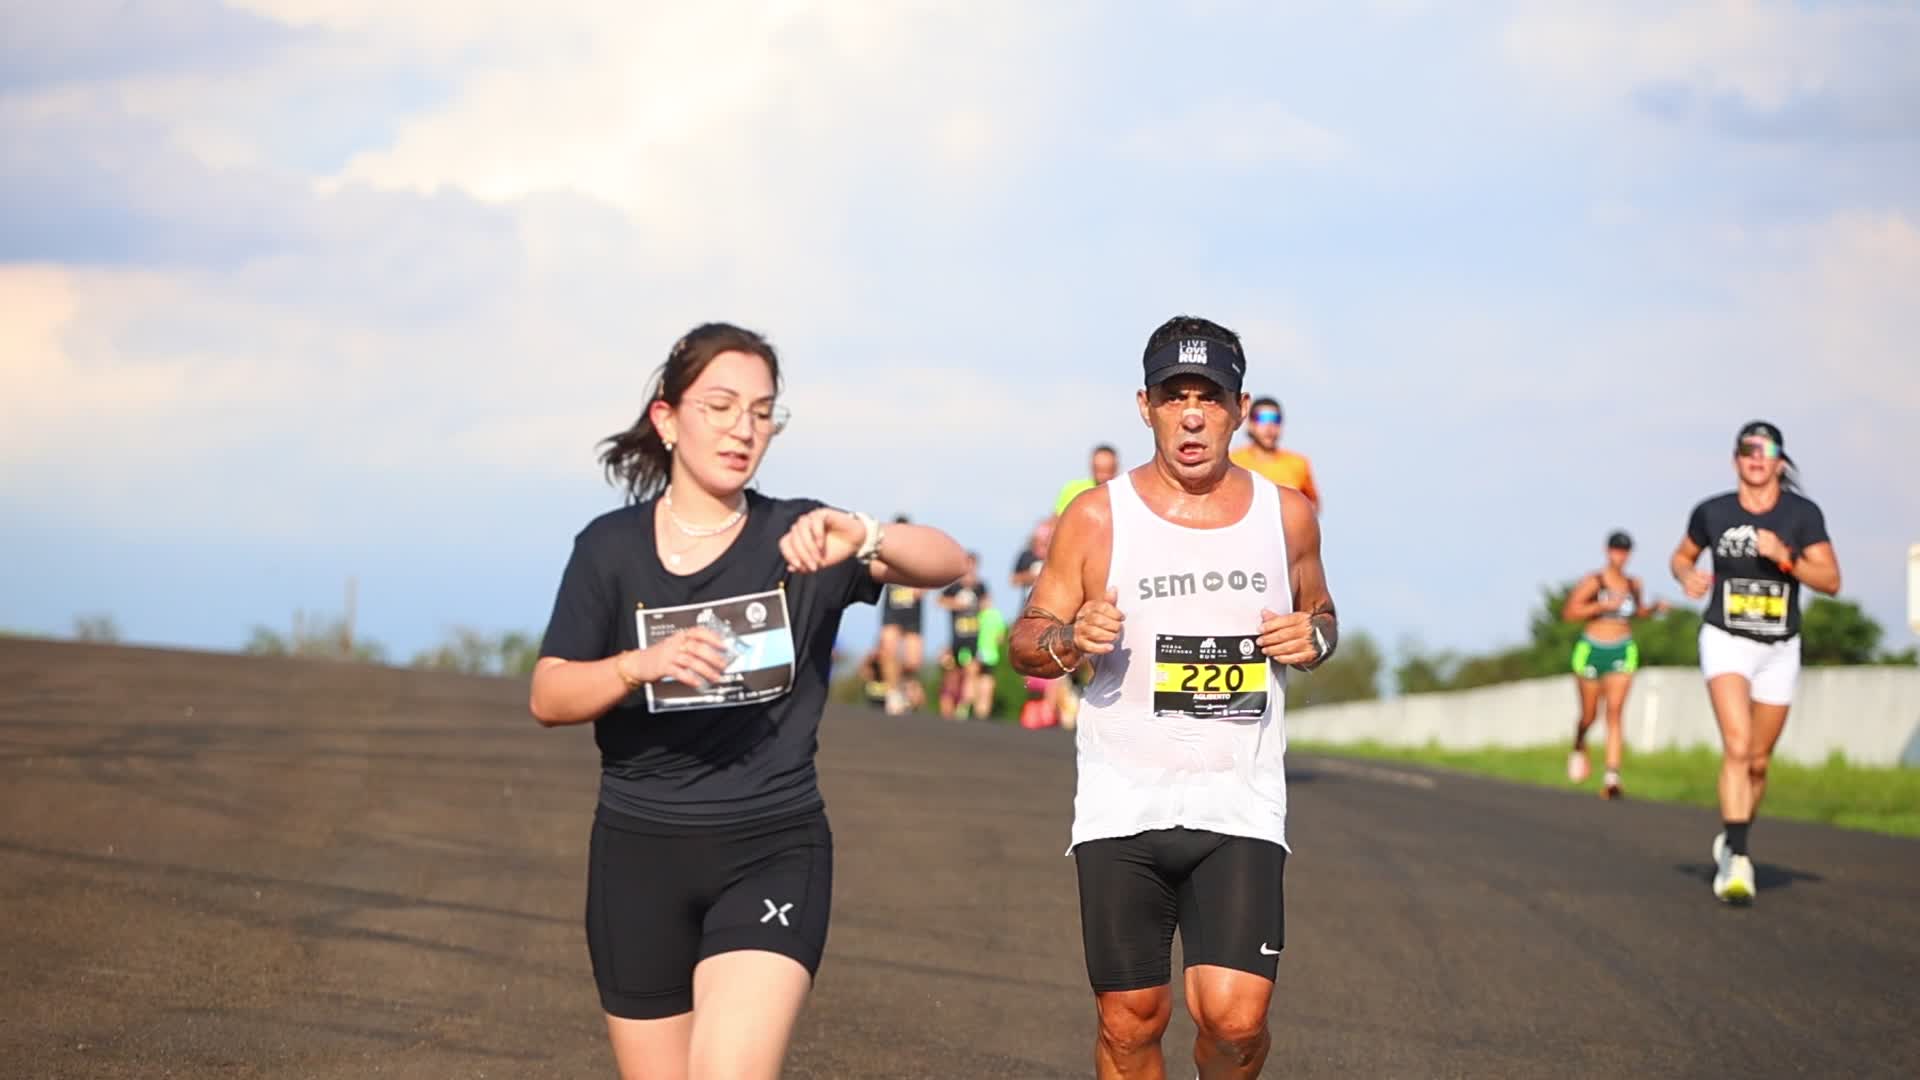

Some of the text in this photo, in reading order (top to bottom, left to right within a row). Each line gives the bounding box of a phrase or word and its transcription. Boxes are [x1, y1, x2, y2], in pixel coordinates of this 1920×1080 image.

[1179, 340, 1207, 348] LIVE
[1179, 353, 1208, 364] RUN
[1138, 572, 1197, 600] SEM
[1181, 664, 1244, 692] 220
